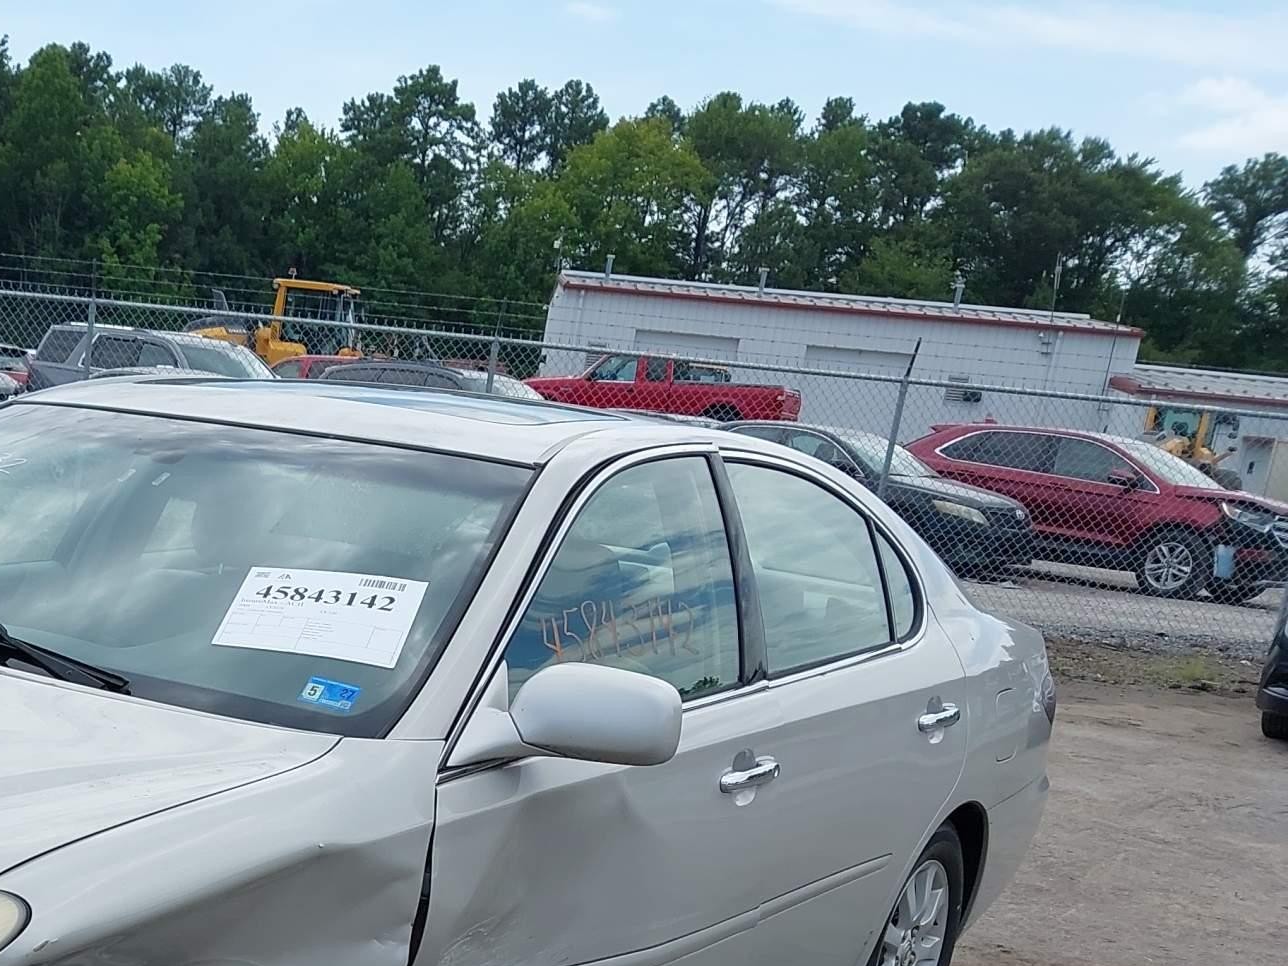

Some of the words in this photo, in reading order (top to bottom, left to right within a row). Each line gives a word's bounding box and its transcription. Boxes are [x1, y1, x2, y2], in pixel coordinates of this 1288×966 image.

[255, 584, 396, 612] 45843142
[540, 597, 700, 664] 45843142
[307, 685, 320, 697] 5
[340, 688, 356, 700] 27
